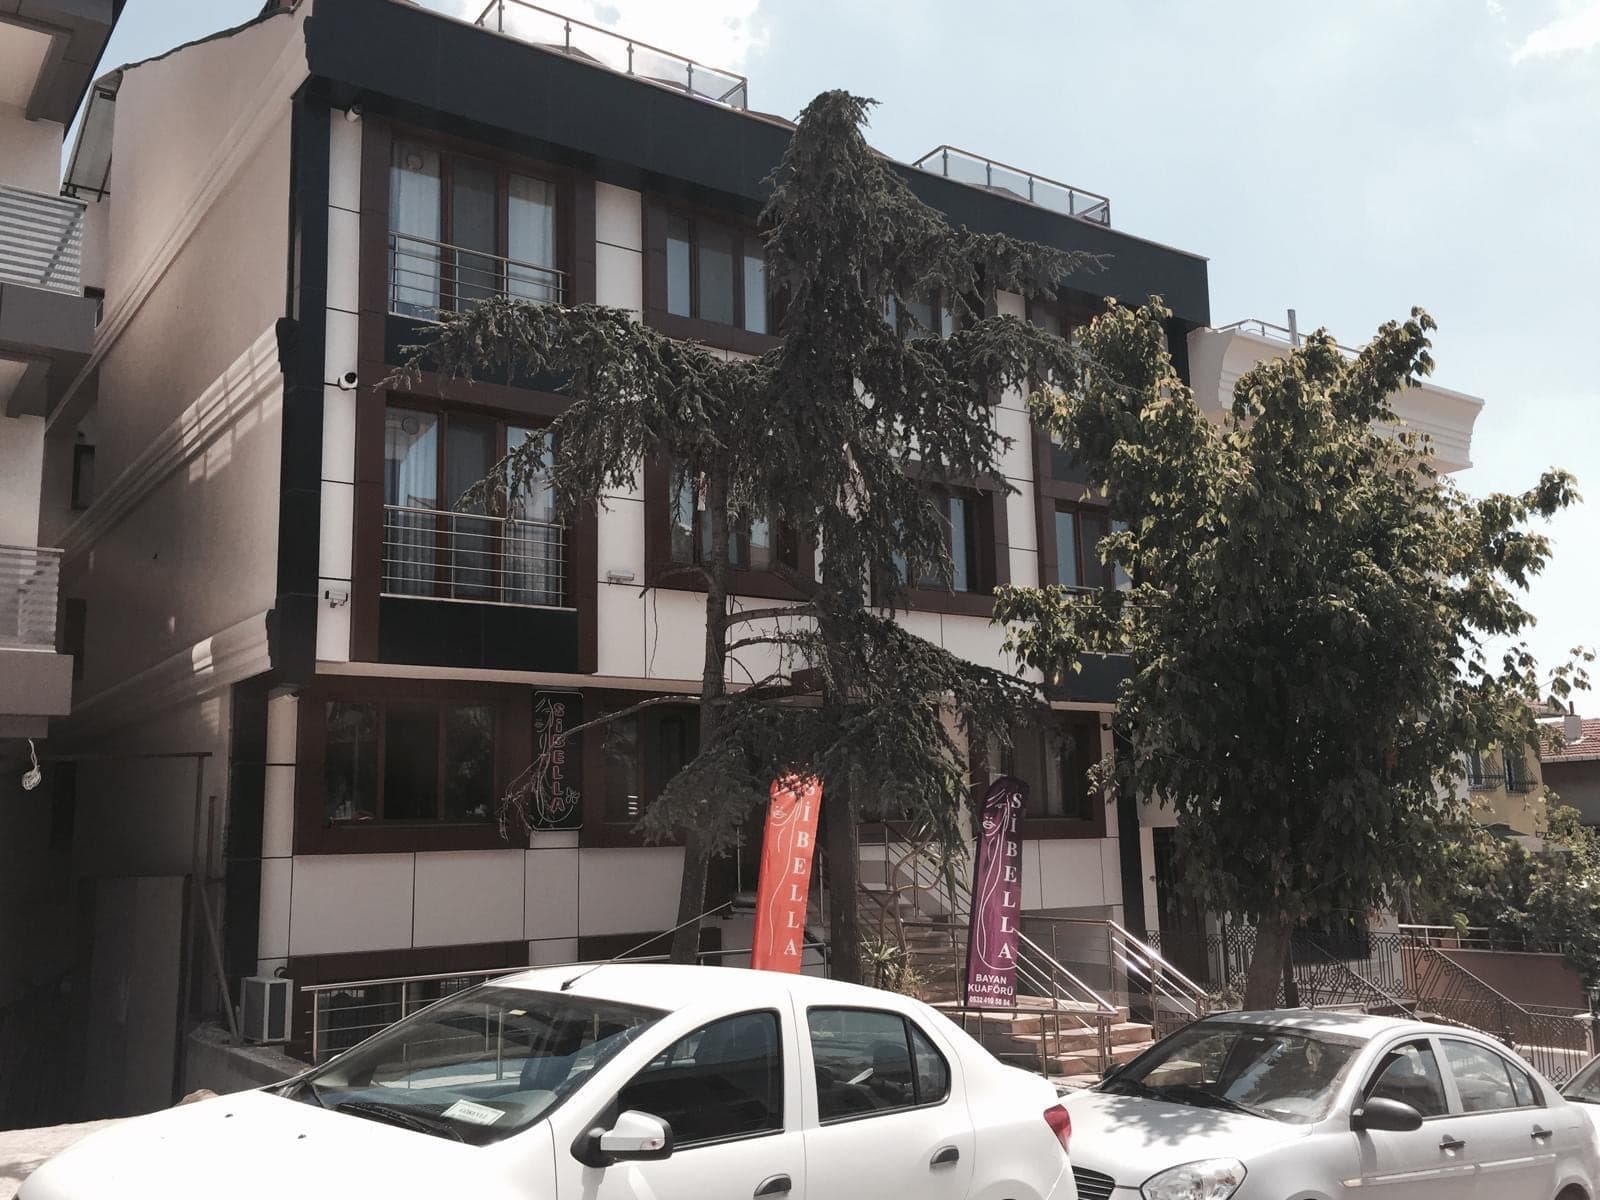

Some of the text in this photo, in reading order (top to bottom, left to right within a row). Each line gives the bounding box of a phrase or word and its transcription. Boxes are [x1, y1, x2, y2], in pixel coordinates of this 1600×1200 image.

[998, 792, 1022, 959] SİBELLA
[976, 974, 1007, 985] BAYAN
[967, 984, 1013, 996] KUAFÖRÜ
